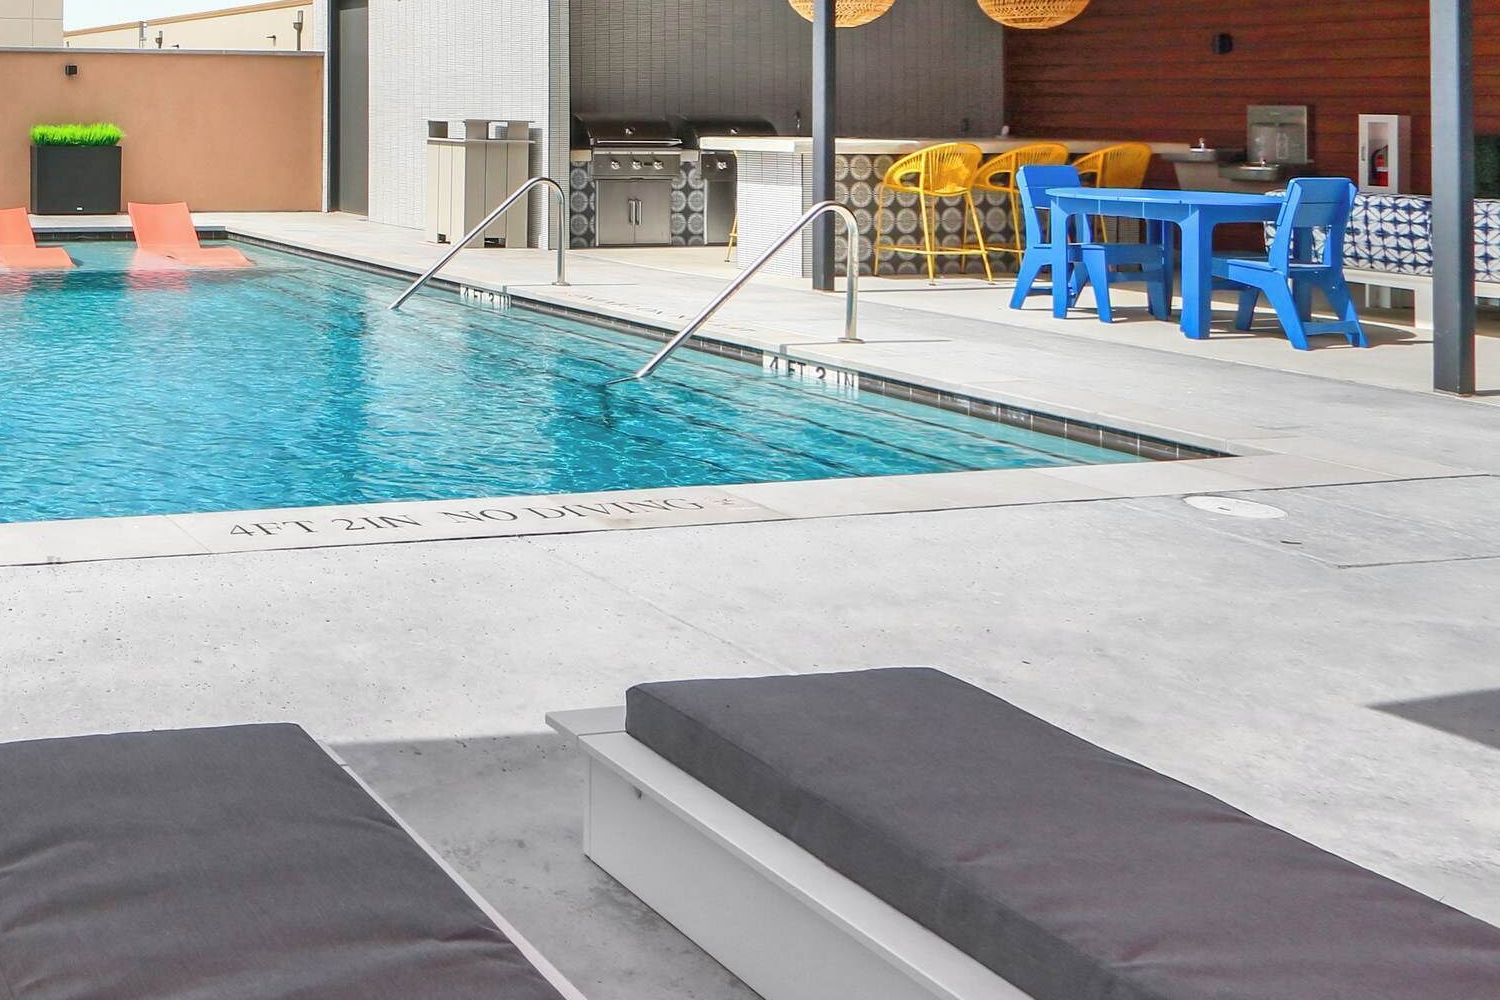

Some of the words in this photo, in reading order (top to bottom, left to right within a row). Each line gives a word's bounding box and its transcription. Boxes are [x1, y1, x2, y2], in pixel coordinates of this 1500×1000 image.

[229, 519, 320, 537] 4FT
[331, 513, 423, 532] 2IN
[438, 508, 519, 524] NO
[521, 497, 706, 520] DIVING
